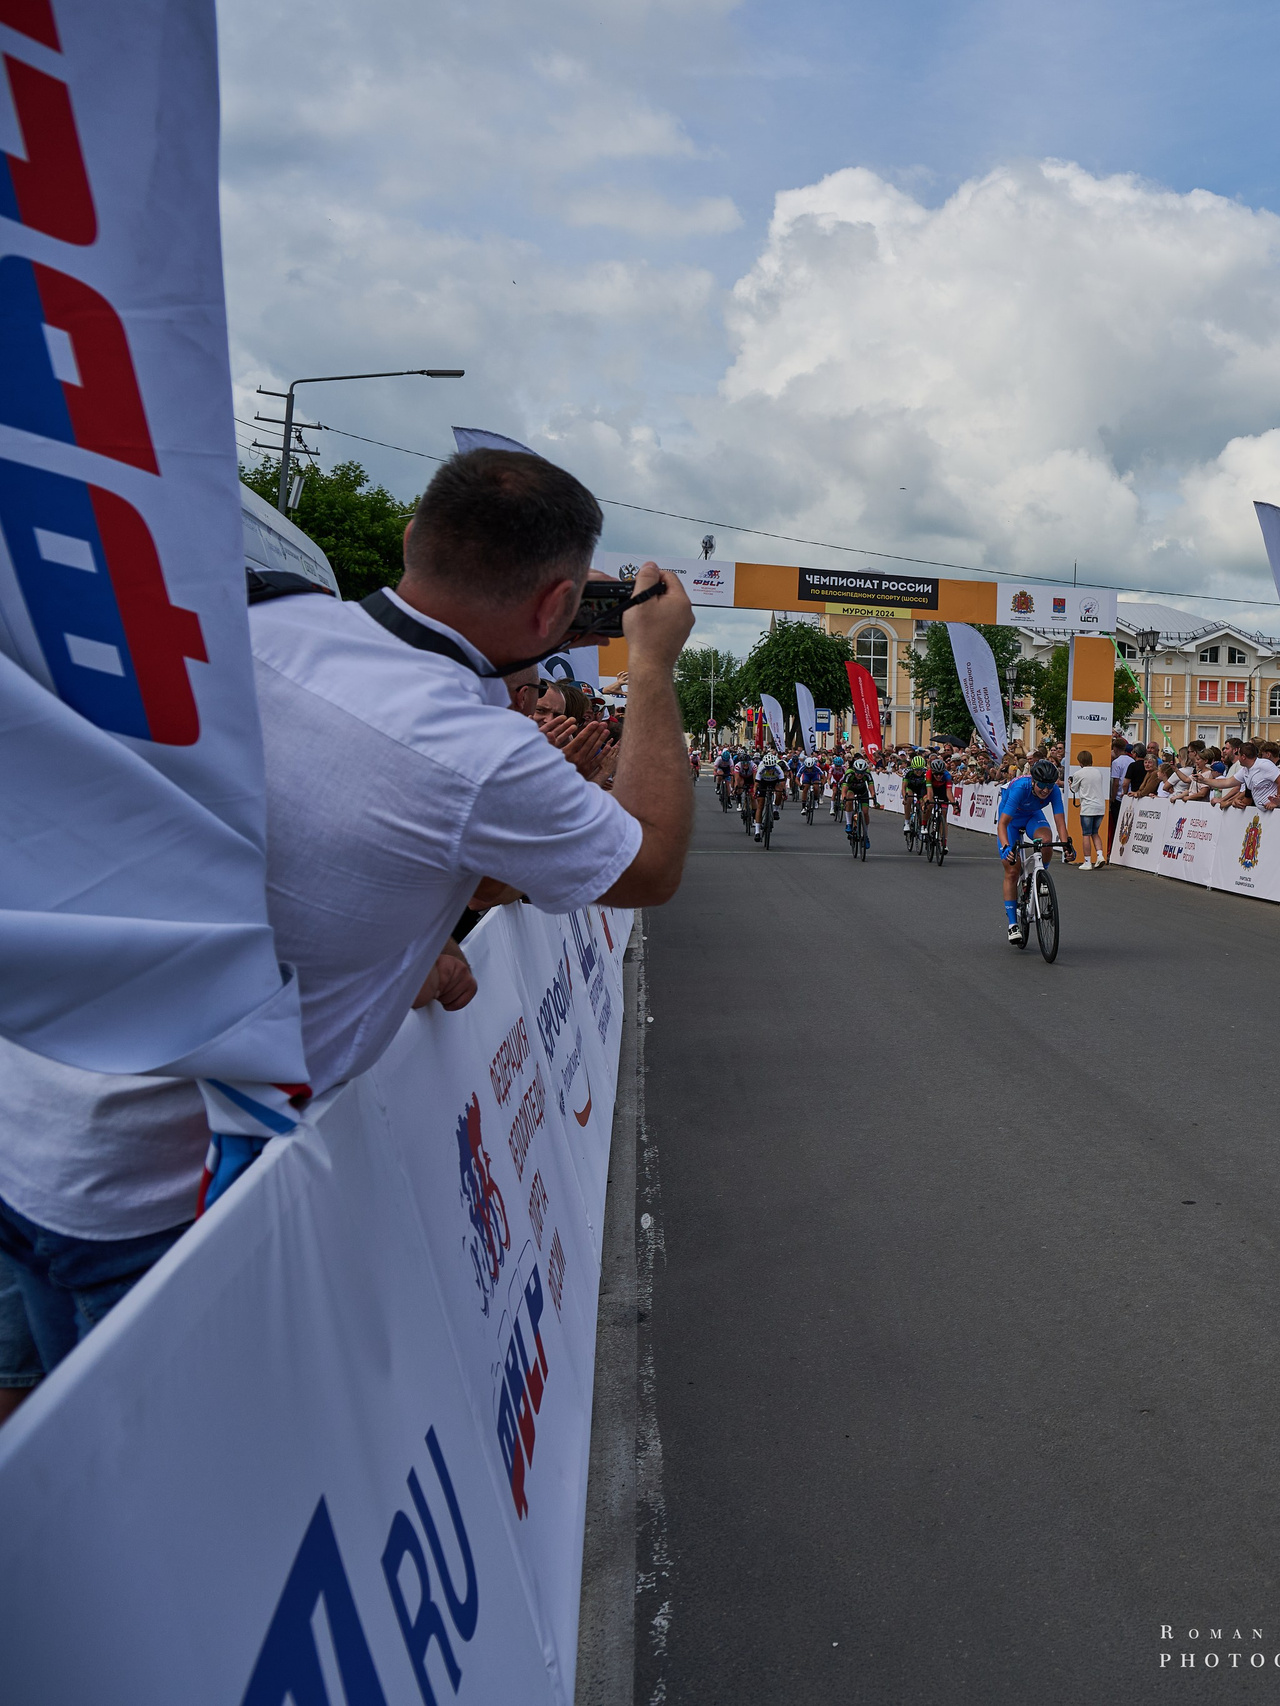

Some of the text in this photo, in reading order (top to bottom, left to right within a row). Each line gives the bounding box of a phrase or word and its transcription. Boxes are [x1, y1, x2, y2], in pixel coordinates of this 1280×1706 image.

[805, 574, 933, 594] ЧЕМПИОНАТ РОССИИ
[821, 589, 875, 599] ВЕЛОСИПЕДНОМУ
[876, 593, 901, 601] СПОРТУ
[901, 596, 929, 604] (ШОССЕ)
[842, 607, 895, 617] МУРОМ 2024
